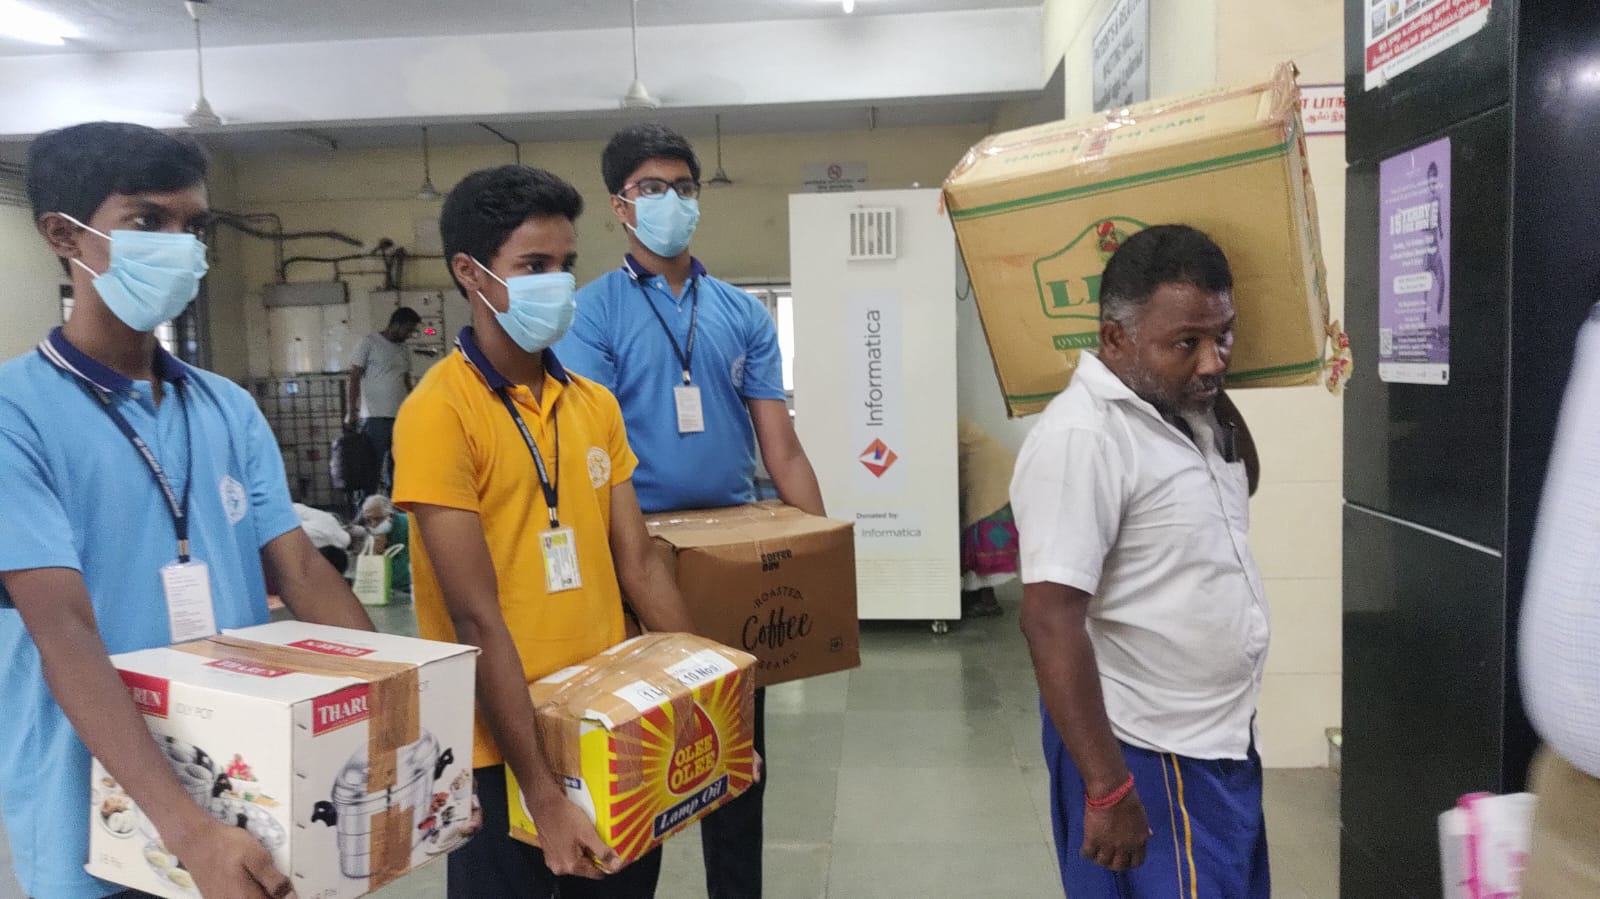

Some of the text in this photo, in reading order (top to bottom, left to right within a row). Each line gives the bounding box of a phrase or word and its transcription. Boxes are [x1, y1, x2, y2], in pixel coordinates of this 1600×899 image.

[864, 309, 884, 427] Informatica
[861, 527, 922, 537] Informatica
[742, 606, 813, 651] Coffee
[671, 751, 717, 789] OLEE
[675, 735, 713, 767] OLEE
[660, 780, 723, 829] Lamp Oil
